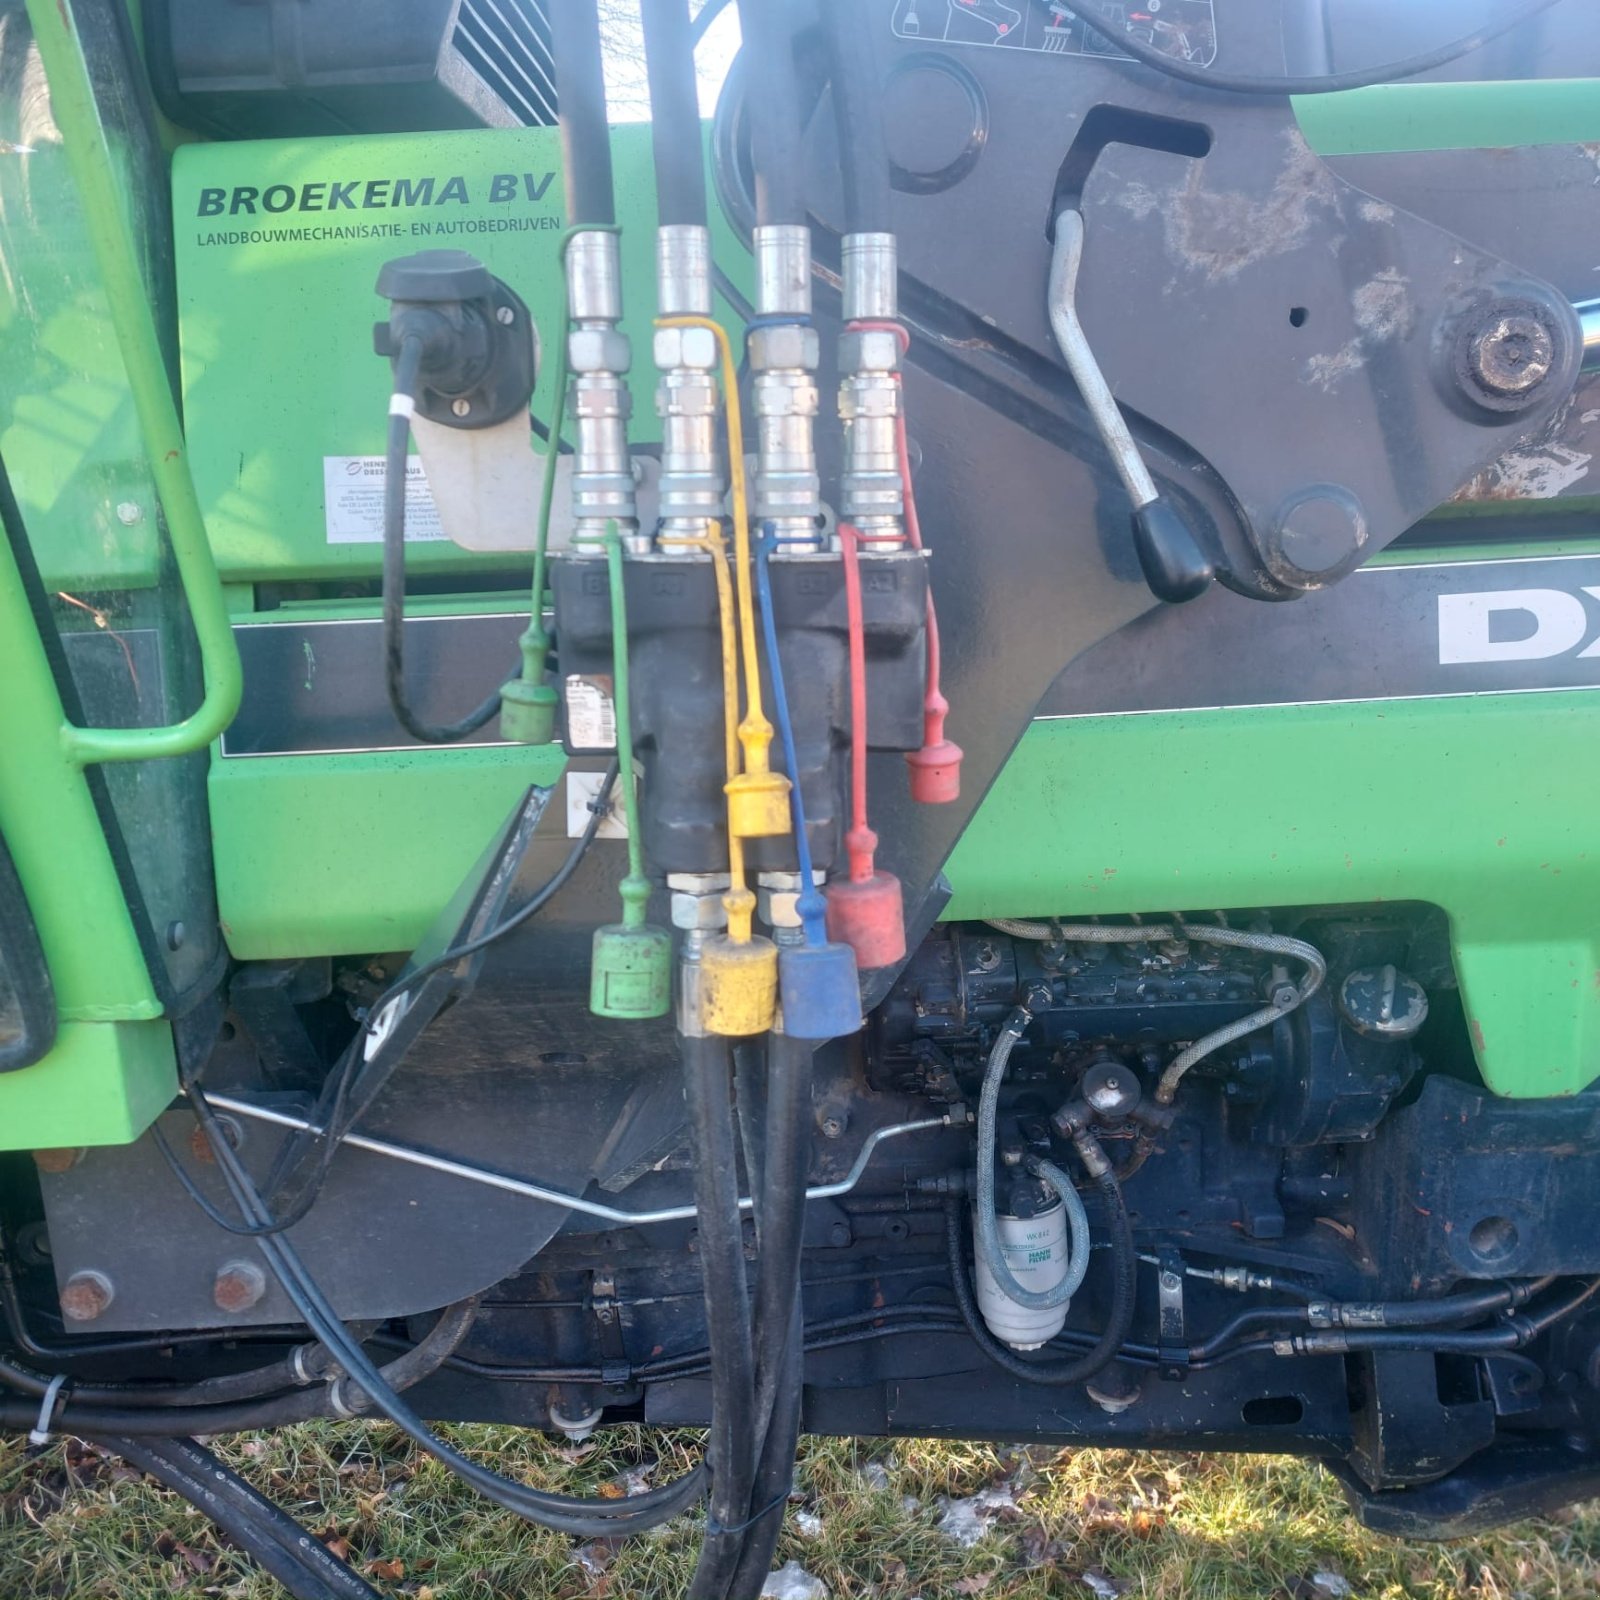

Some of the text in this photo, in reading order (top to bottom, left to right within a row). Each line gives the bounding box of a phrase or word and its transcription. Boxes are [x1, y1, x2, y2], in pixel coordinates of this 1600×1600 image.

[197, 172, 556, 217] BROEKEMA BV
[197, 217, 561, 246] LANDBOUWMECHANISATIE- EN AUTOBEDRIJVEN
